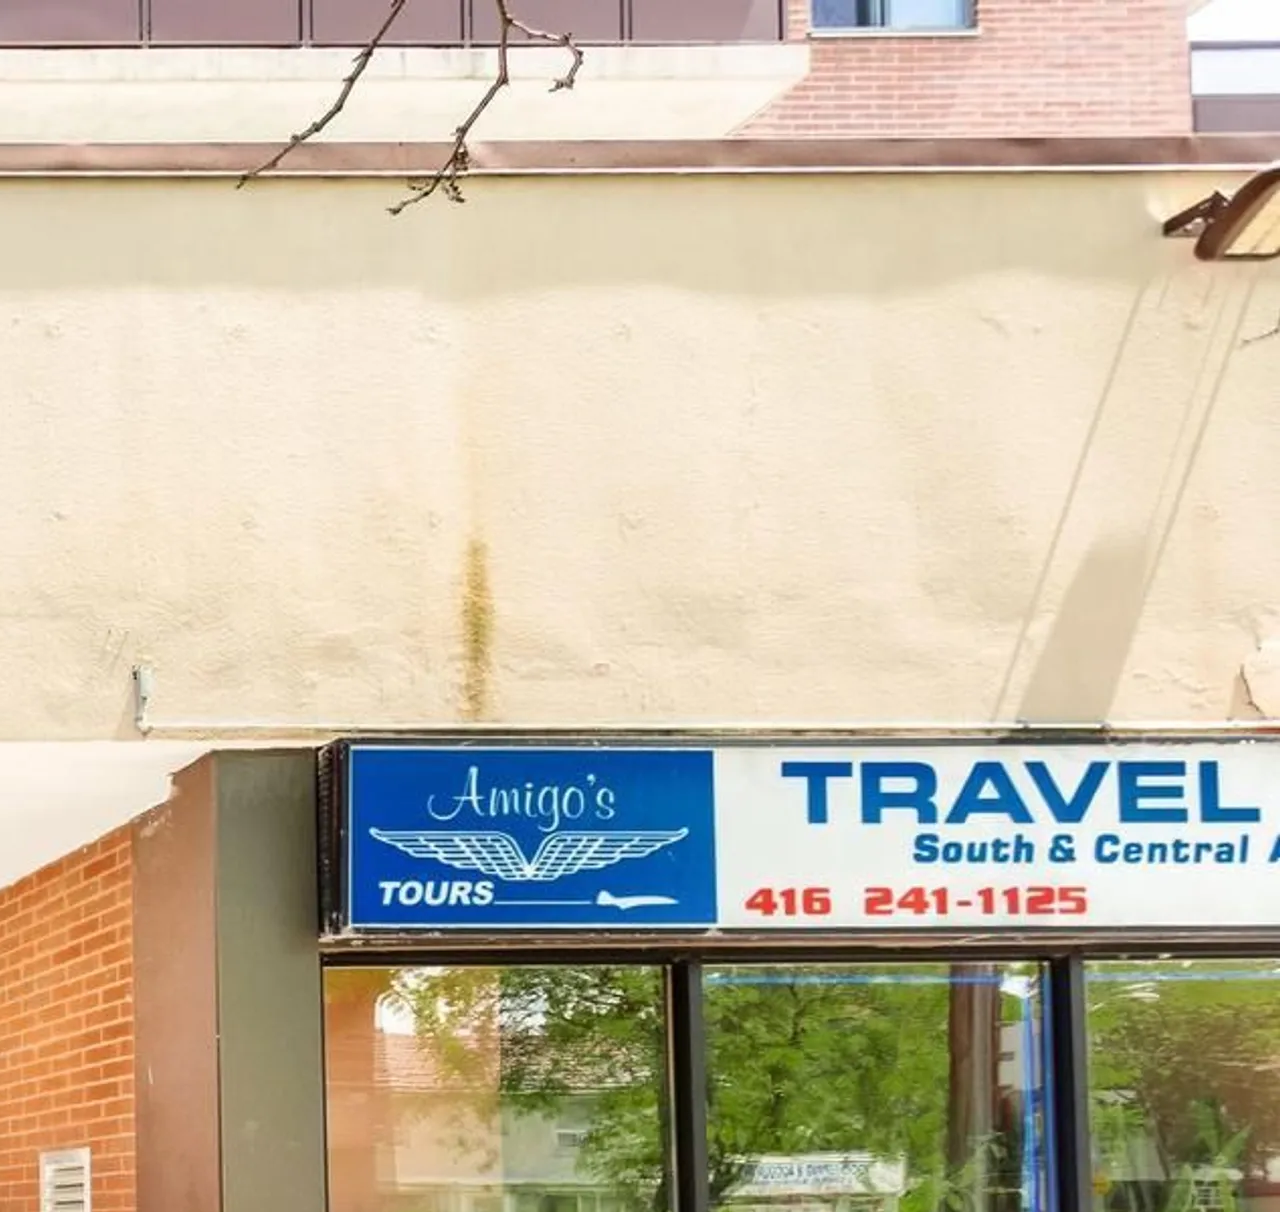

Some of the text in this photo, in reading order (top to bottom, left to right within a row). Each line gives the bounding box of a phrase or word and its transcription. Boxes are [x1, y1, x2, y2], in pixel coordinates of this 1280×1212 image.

[427, 766, 616, 832] Amigo's
[781, 761, 1261, 824] TRAVEL
[913, 833, 1035, 864] South
[1048, 834, 1077, 864] &
[1094, 833, 1249, 864] Central
[378, 880, 495, 906] TOURS
[745, 886, 1088, 916] 416 241-1125
